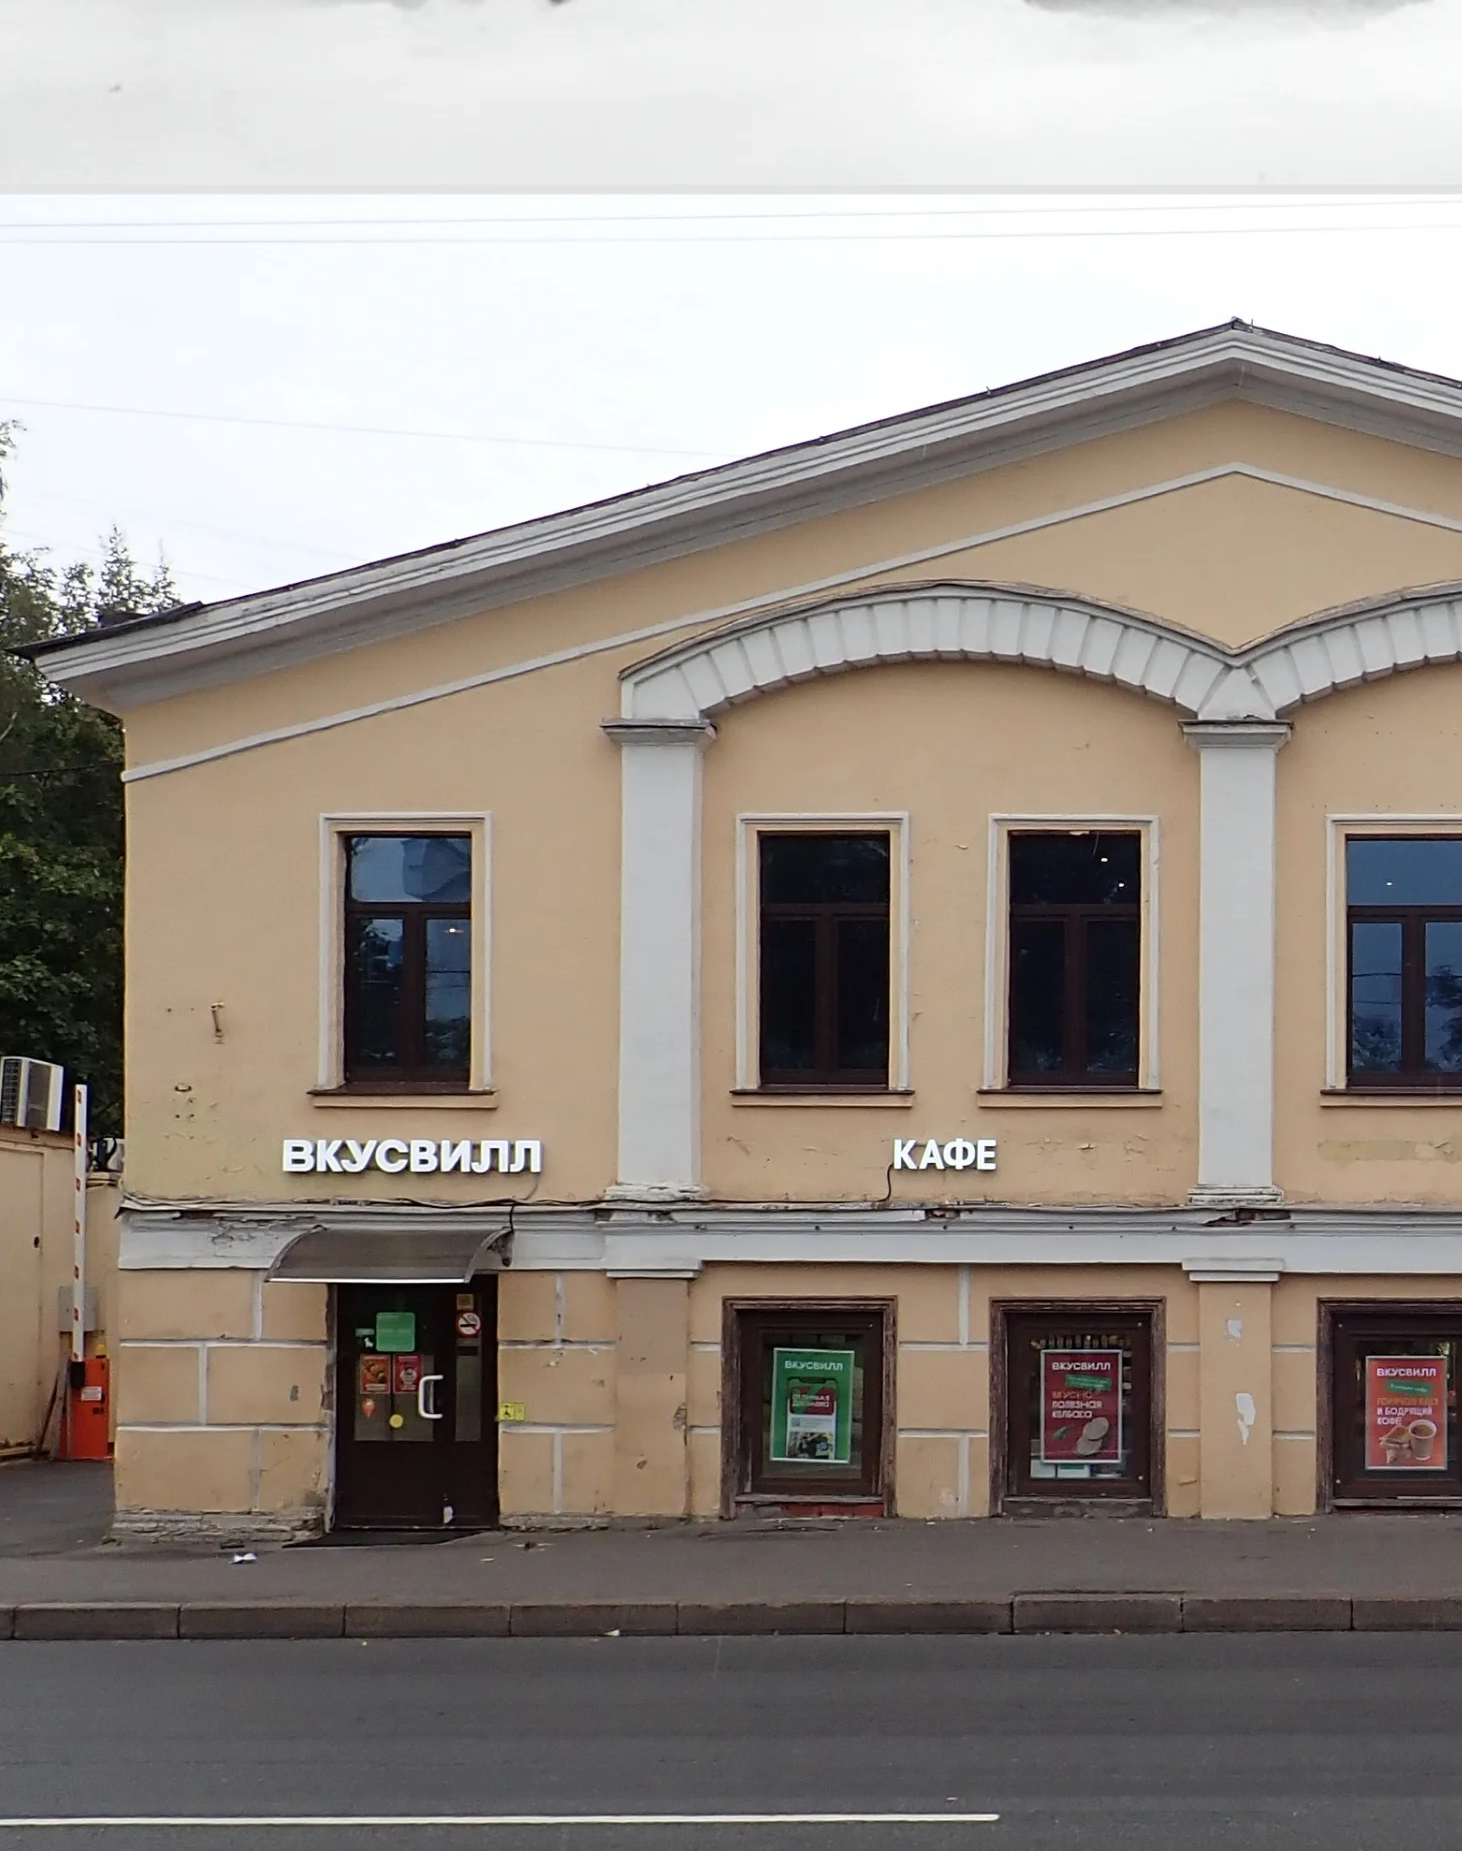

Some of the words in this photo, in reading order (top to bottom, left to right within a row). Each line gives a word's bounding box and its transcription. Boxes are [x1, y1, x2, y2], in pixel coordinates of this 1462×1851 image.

[282, 1139, 541, 1173] ВКУСВИЛЛ
[893, 1138, 998, 1170] КАФЕ
[784, 1360, 844, 1371] ВКУСВИЛЛ
[1051, 1361, 1111, 1371] ВКУСВИЛЛ
[1376, 1367, 1437, 1377] ВКУСВИЛЛ
